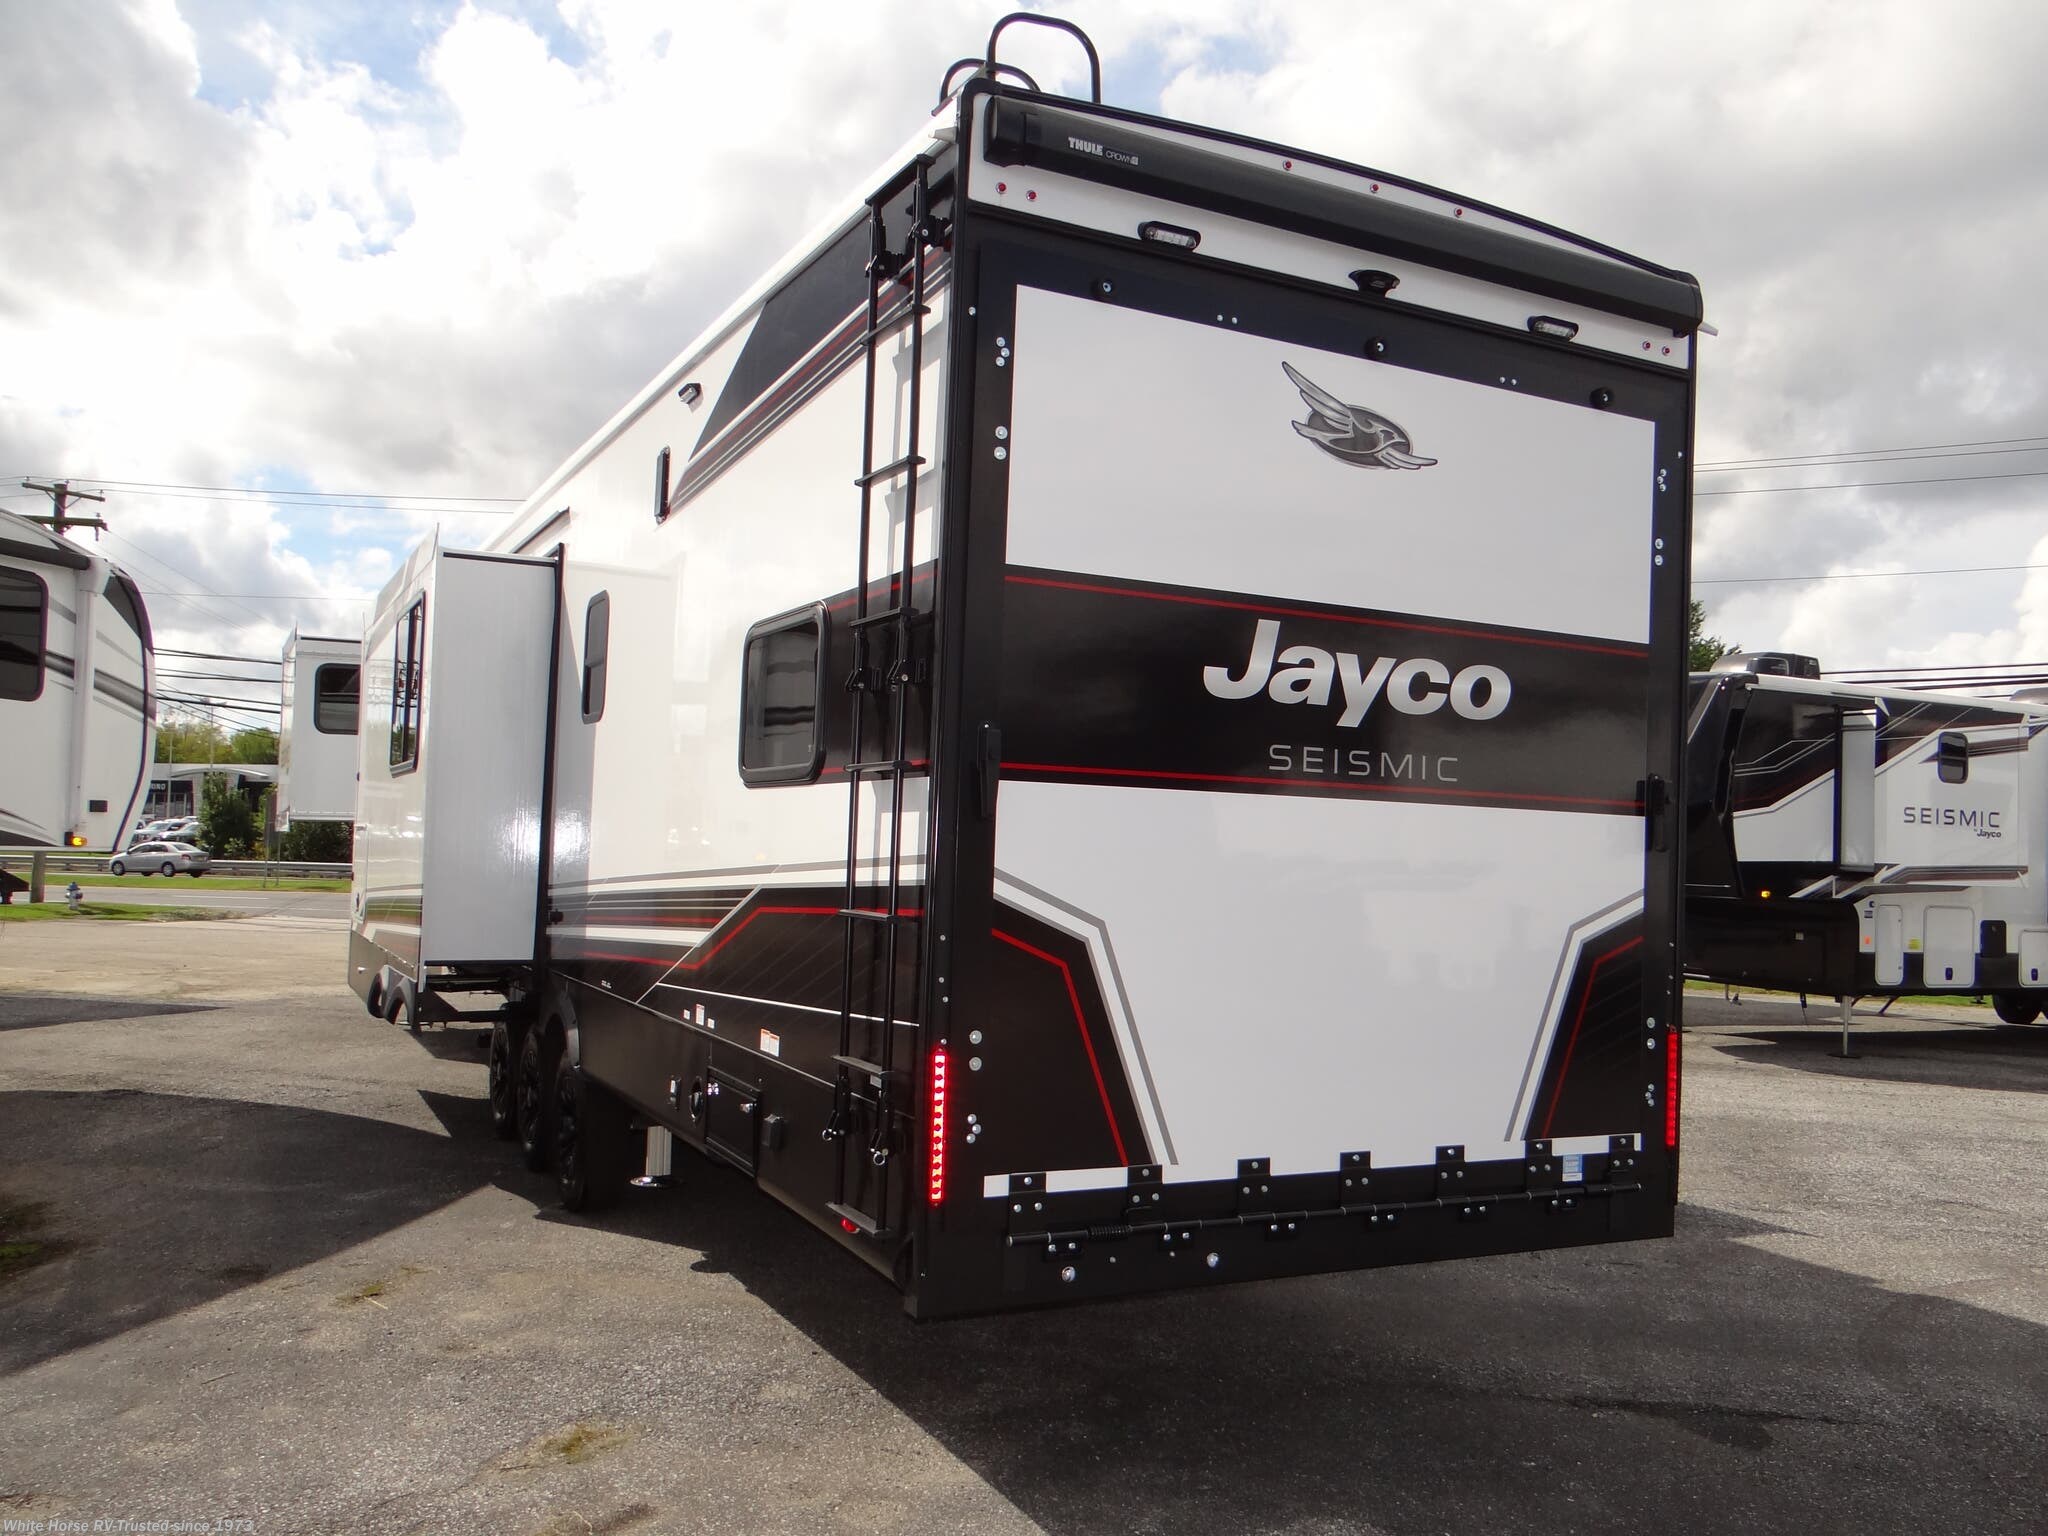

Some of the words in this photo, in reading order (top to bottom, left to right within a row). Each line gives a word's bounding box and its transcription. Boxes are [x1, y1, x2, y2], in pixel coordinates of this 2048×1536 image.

[1068, 136, 1104, 156] THULE
[1203, 619, 1512, 728] Jayco
[1268, 744, 1458, 782] SEISMIC
[1903, 806, 2000, 828] SEISMIC
[1977, 828, 2002, 839] Jayco
